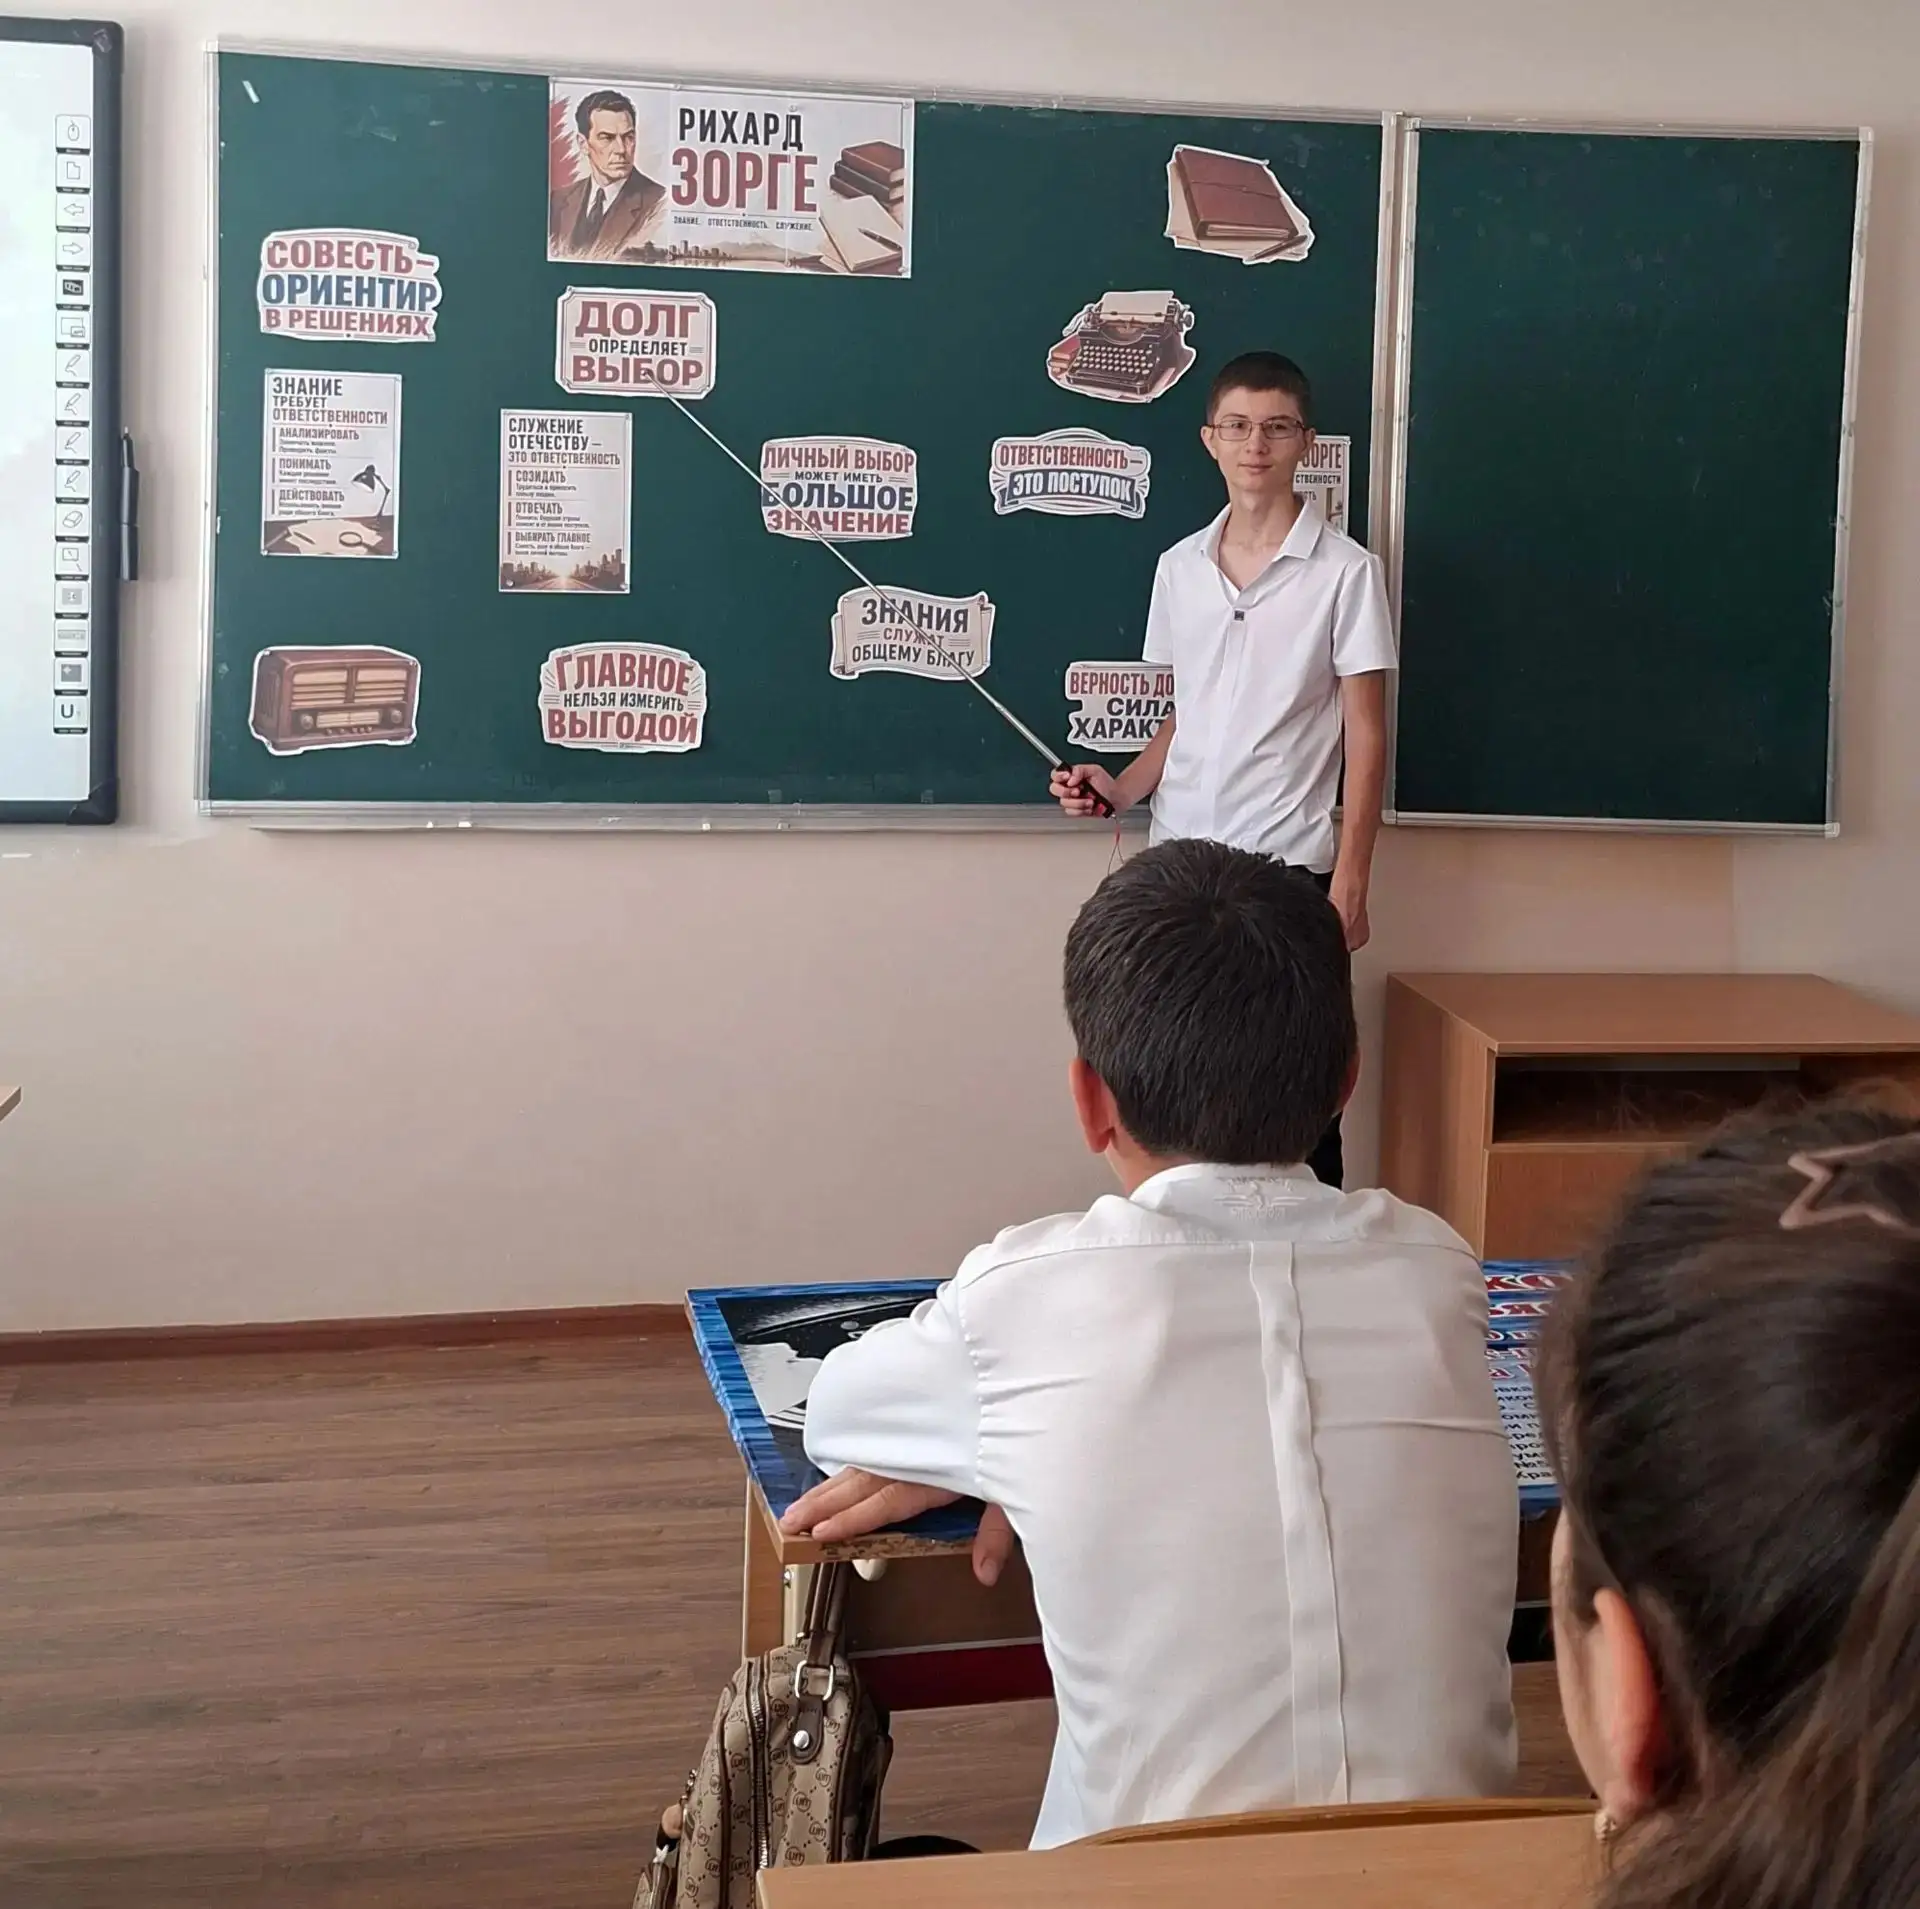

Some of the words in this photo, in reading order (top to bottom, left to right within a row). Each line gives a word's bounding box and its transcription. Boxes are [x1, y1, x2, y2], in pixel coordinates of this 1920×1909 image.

[679, 107, 803, 152] РИХАРД
[671, 148, 819, 213] ЗОРГЕ
[262, 273, 437, 312] ОРИЕНТИР
[266, 308, 281, 328] В
[289, 309, 430, 336] РЕШЕНИЯХ
[575, 301, 700, 338] ДОЛГ
[588, 338, 688, 356] ОПРЕДЕЛЯЕТ
[572, 355, 704, 386] ВЫБОР
[272, 376, 343, 396] ЗНАНИЕ
[273, 395, 328, 408] ТРЕБУЕТ
[272, 408, 388, 425] ОТВЕТСТВЕННОСТИ
[509, 417, 584, 434] СЛУЖЕНИЕ
[279, 427, 360, 440] АНАЛИЗИРОВАТЬ
[509, 434, 589, 451] ОТЕЧЕСТВУ
[279, 457, 332, 470] ПОНИМАТЬ
[508, 451, 527, 463] ЭТО
[531, 451, 621, 465] ОТВЕТСТВЕННОСТЬ
[763, 445, 848, 469] ЛИЧНЫЙ
[855, 449, 914, 473] ВЫБОР
[1001, 445, 1128, 469] ОТВЕТСТВЕННОСТЬ
[516, 470, 566, 483] СОЗИДАТЬ
[795, 472, 838, 481] МОЖЕТ
[844, 473, 883, 483] ИМЕТЬ
[1013, 473, 1043, 496] ЭТО
[1048, 472, 1132, 501] ПОСТУПОК
[279, 488, 345, 502] ДЕЙСТВОВАТЬ
[762, 481, 914, 512] БОЛЬШОЕ
[515, 502, 563, 514] ОТВЕЧАТЬ
[767, 510, 909, 534] ЗНАЧЕНИЕ
[515, 532, 555, 543] ВЫБИРАТЬ
[557, 533, 591, 543] ГЛАВНОЕ
[861, 598, 968, 633] ЗНАНИЯ
[883, 627, 944, 646] СЛУЖАТ
[852, 644, 921, 662] ОБЩЕМУ
[927, 650, 974, 667] БЛАГУ
[555, 653, 694, 696] ГЛАВНОЕ
[1070, 672, 1149, 695] ВЕРНОСТЬ
[1153, 673, 1175, 698] ДО
[564, 692, 616, 707] НЕЛЬЗЯ
[620, 692, 684, 711] ИЗМЕРИТЬ
[1107, 698, 1175, 716] СИЛА
[548, 709, 697, 743] ВЫГОДОЙ
[1073, 718, 1165, 739] ХАРАКТ
